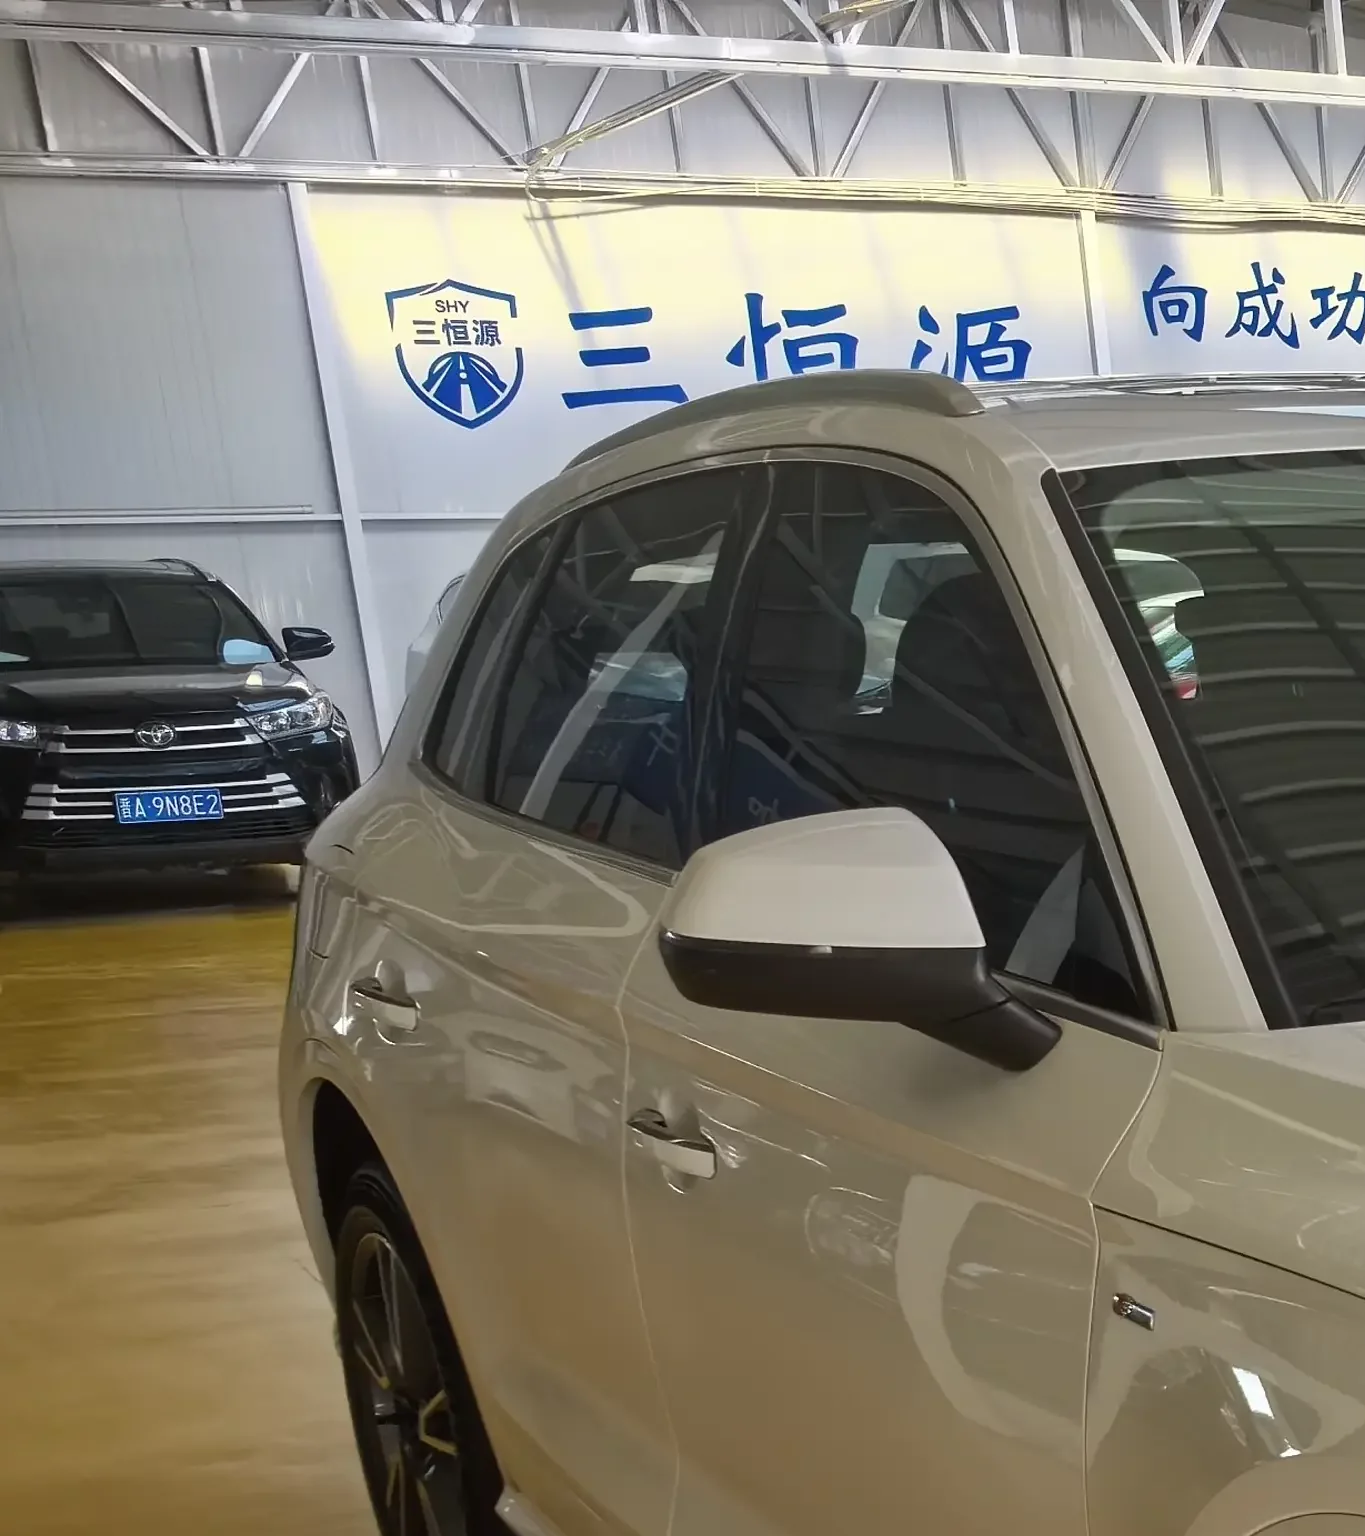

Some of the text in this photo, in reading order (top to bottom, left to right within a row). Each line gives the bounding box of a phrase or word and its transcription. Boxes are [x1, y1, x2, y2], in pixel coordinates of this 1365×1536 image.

[435, 299, 470, 314] SHY
[412, 318, 502, 347] 三恒源
[560, 292, 1033, 410] 三恒源
